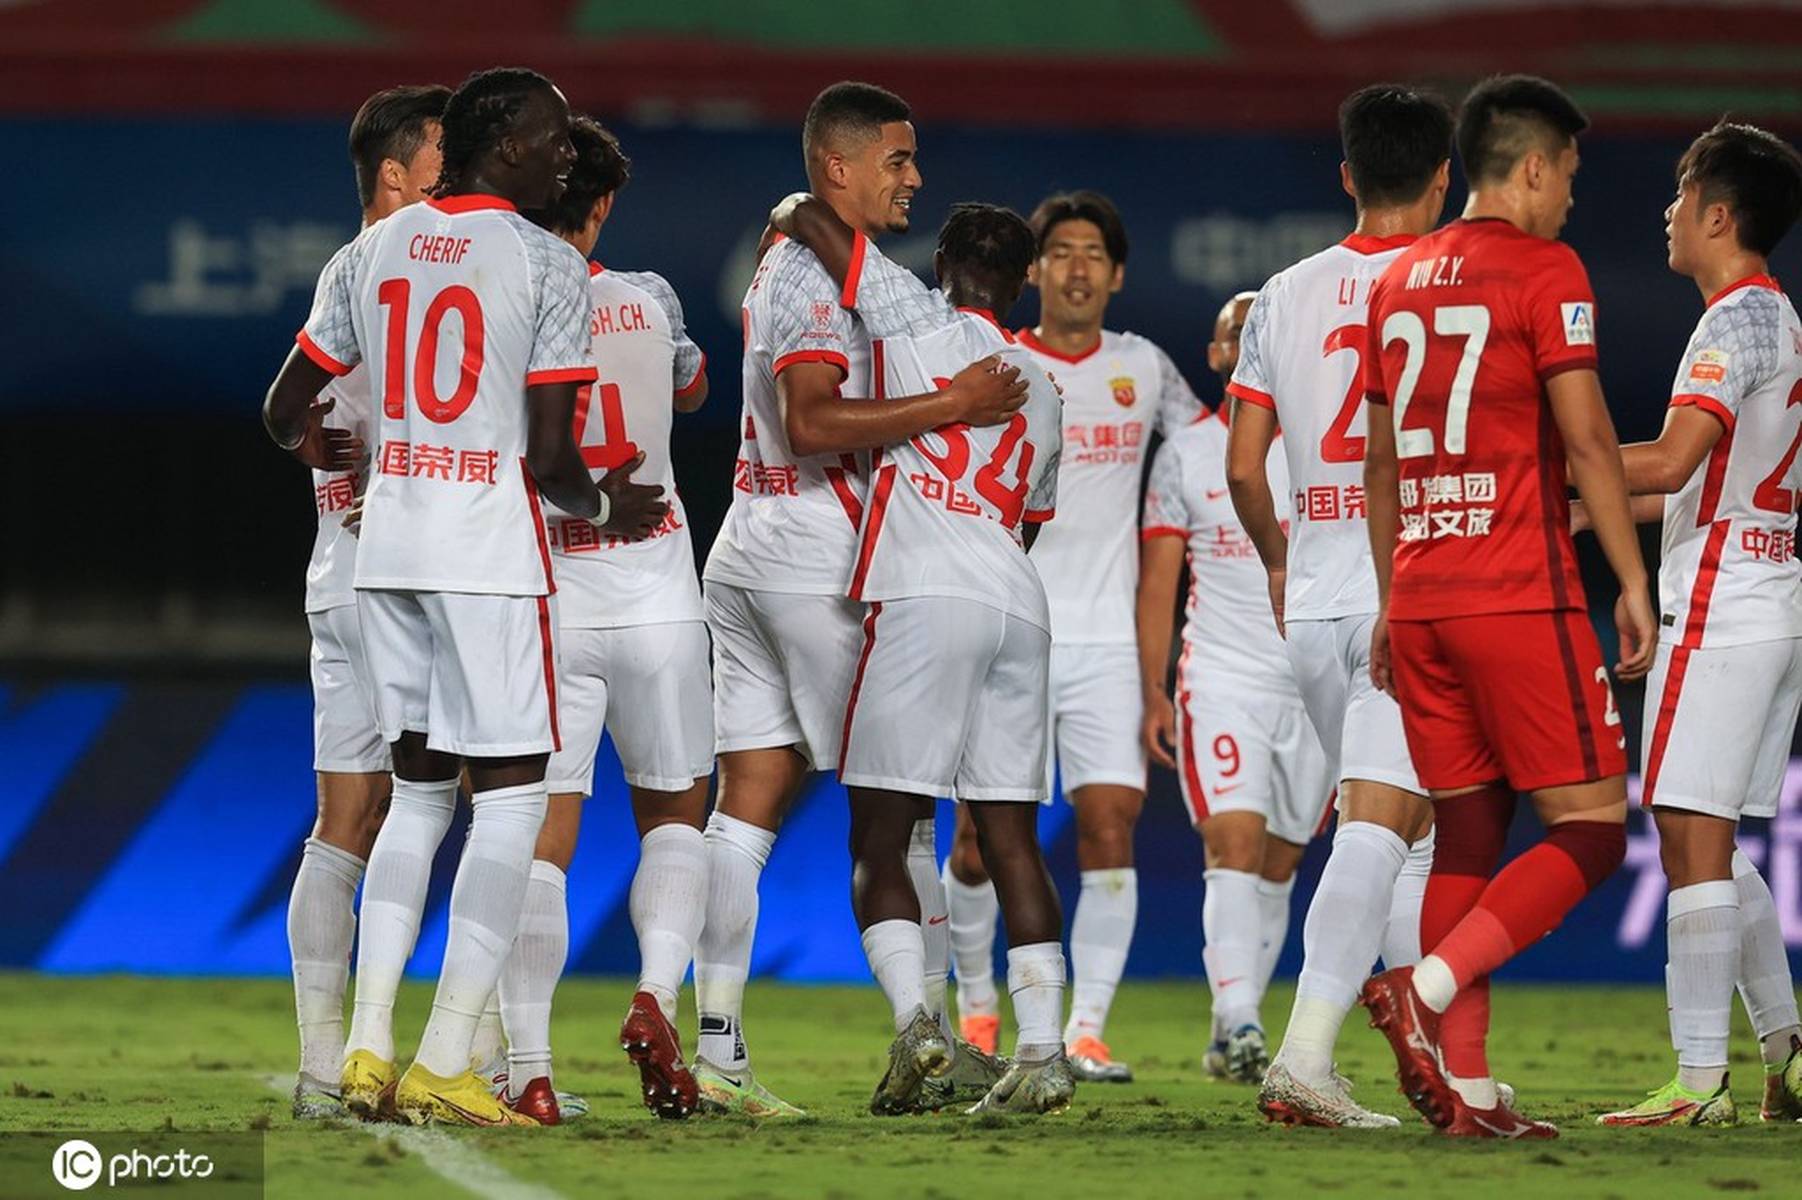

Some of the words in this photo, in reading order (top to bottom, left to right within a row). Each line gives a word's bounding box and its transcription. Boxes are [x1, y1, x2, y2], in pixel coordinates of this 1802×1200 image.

[409, 233, 472, 265] CHERIF
[1338, 277, 1356, 305] LI
[378, 278, 485, 425] 10
[1381, 305, 1490, 459] 27
[376, 440, 499, 485] 国荣威
[1213, 734, 1240, 777] 9
